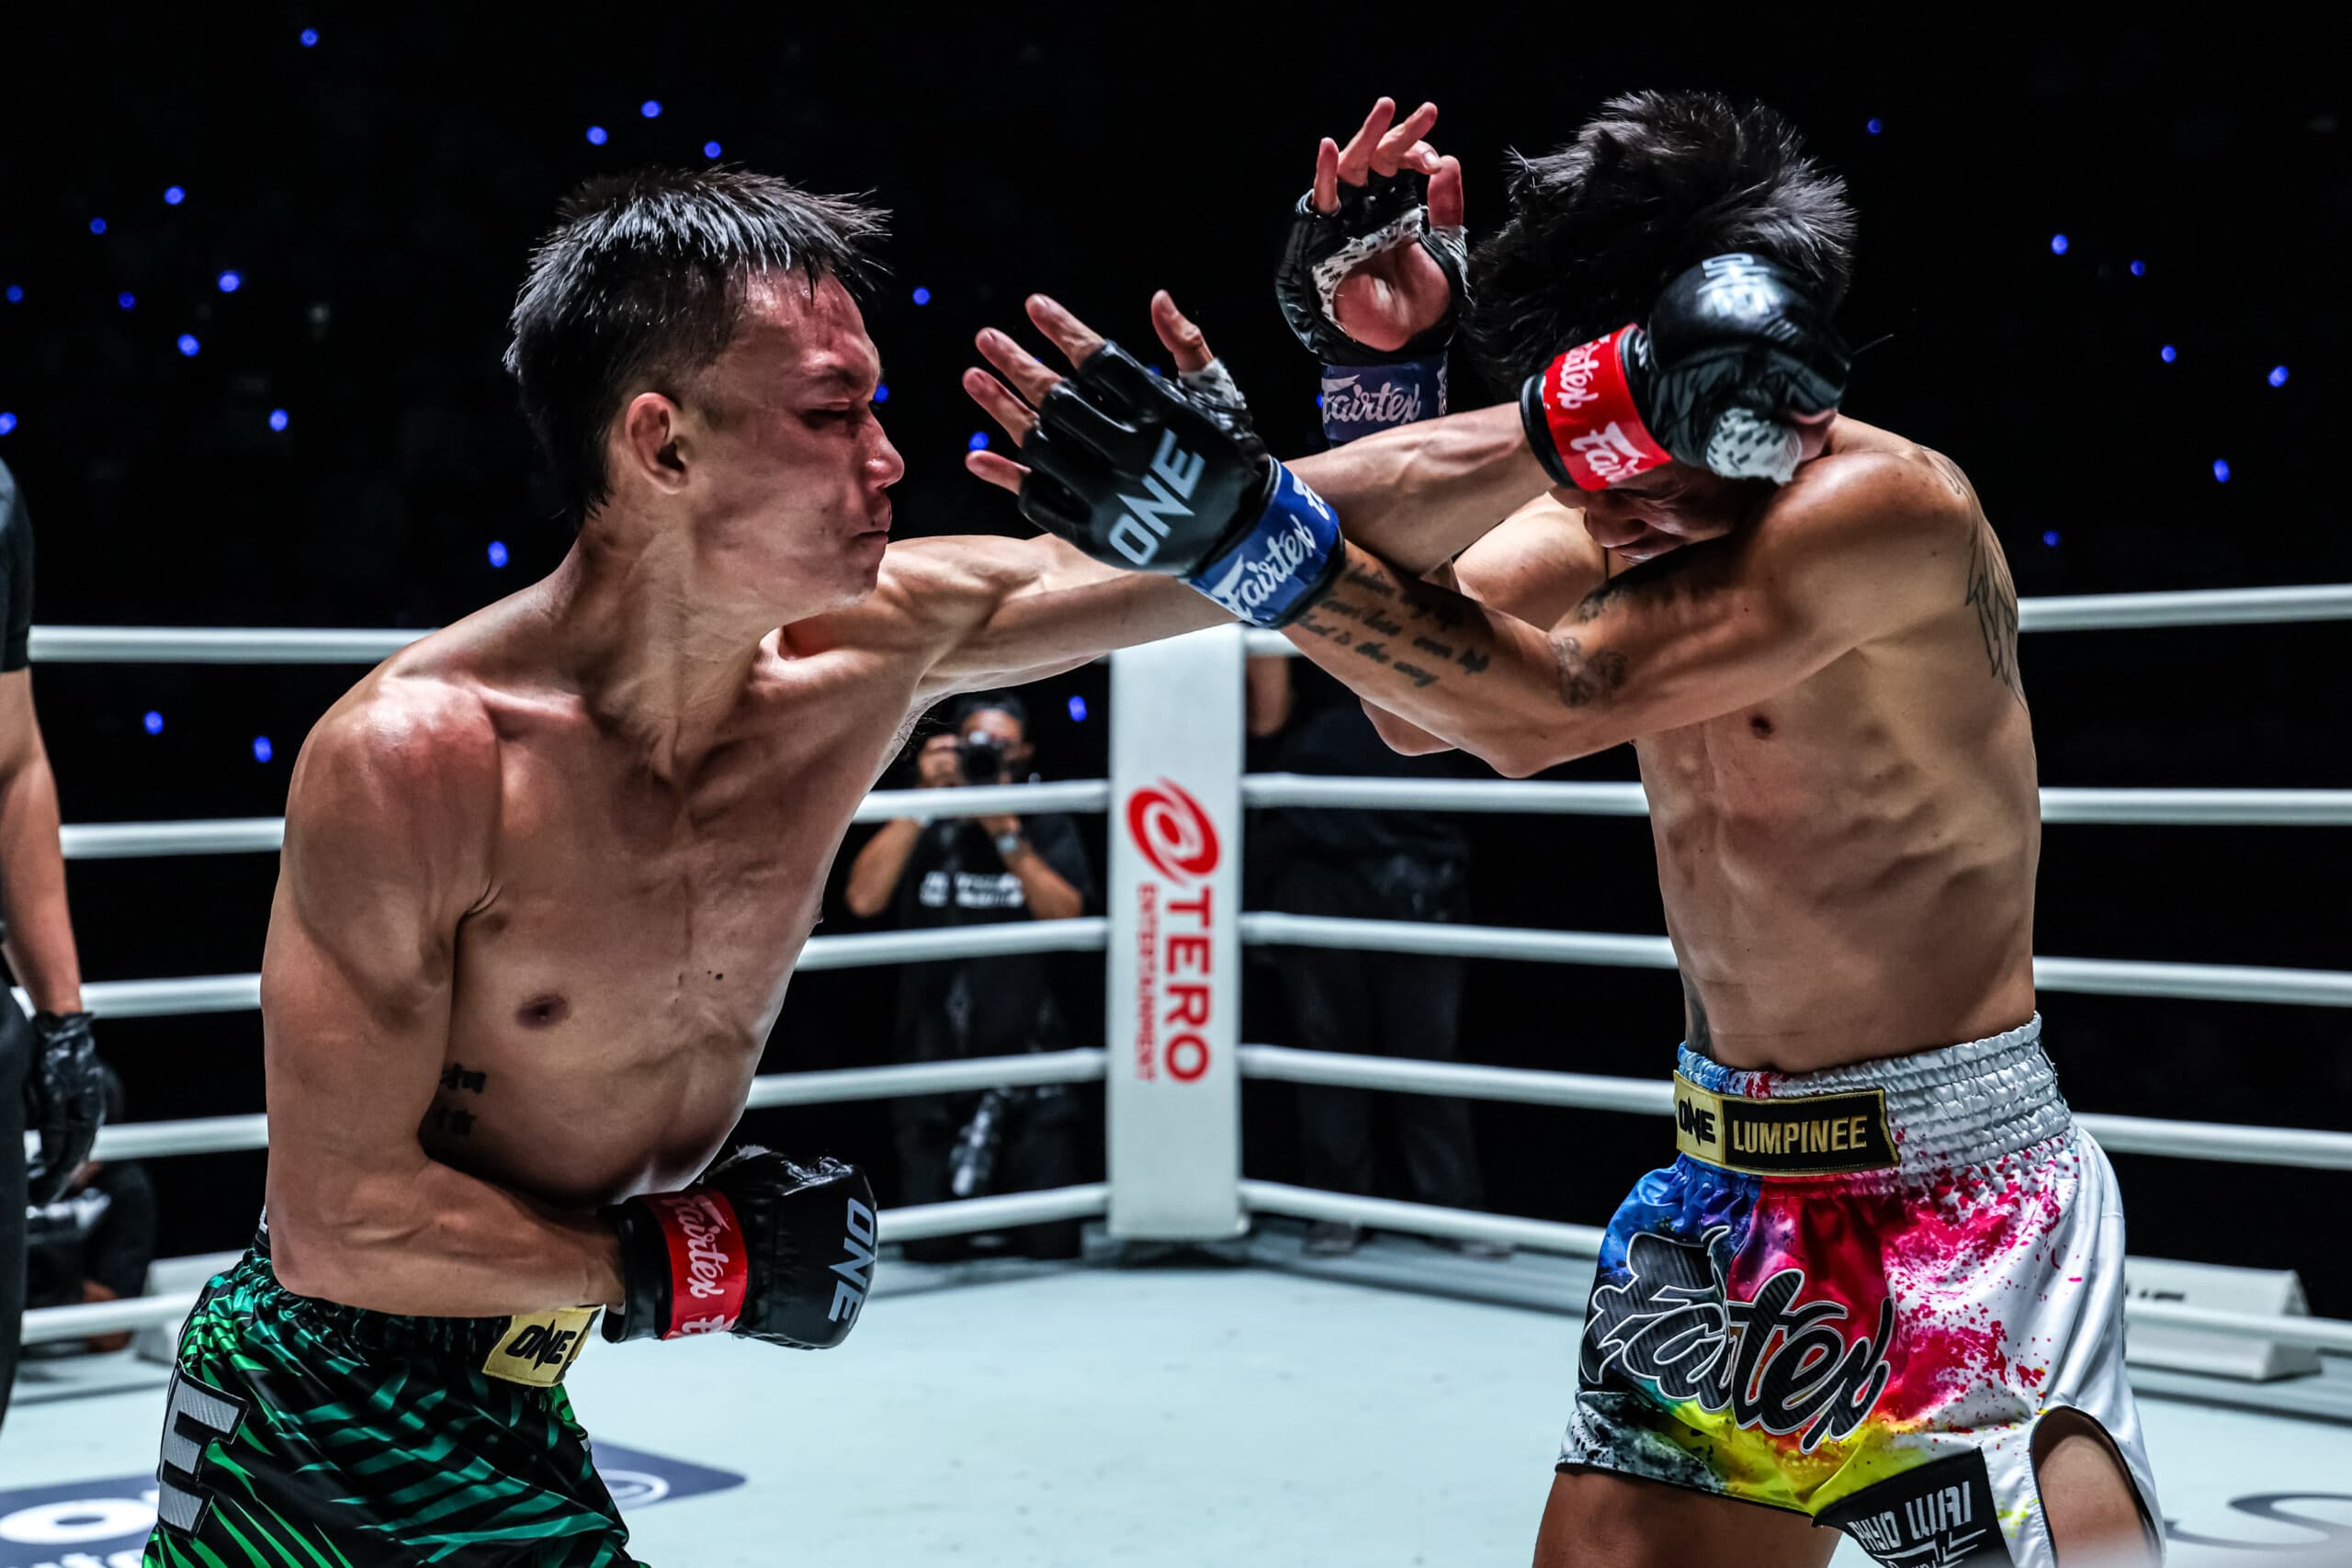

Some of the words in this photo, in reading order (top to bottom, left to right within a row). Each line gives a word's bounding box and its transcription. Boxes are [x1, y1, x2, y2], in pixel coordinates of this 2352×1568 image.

[1321, 374, 1422, 424] Fairtex
[1108, 428, 1205, 566] ONE
[1210, 513, 1317, 623] Fairtex
[1164, 884, 1213, 1084] TERO
[1678, 1096, 1716, 1147] ONE
[1733, 1114, 1868, 1155] LUMPINEE
[661, 1194, 731, 1299] Fairtex
[829, 1197, 876, 1329] ONE
[505, 1318, 577, 1371] ONE
[1579, 1225, 1895, 1455] Faitex
[1905, 1481, 1972, 1540] WAI
